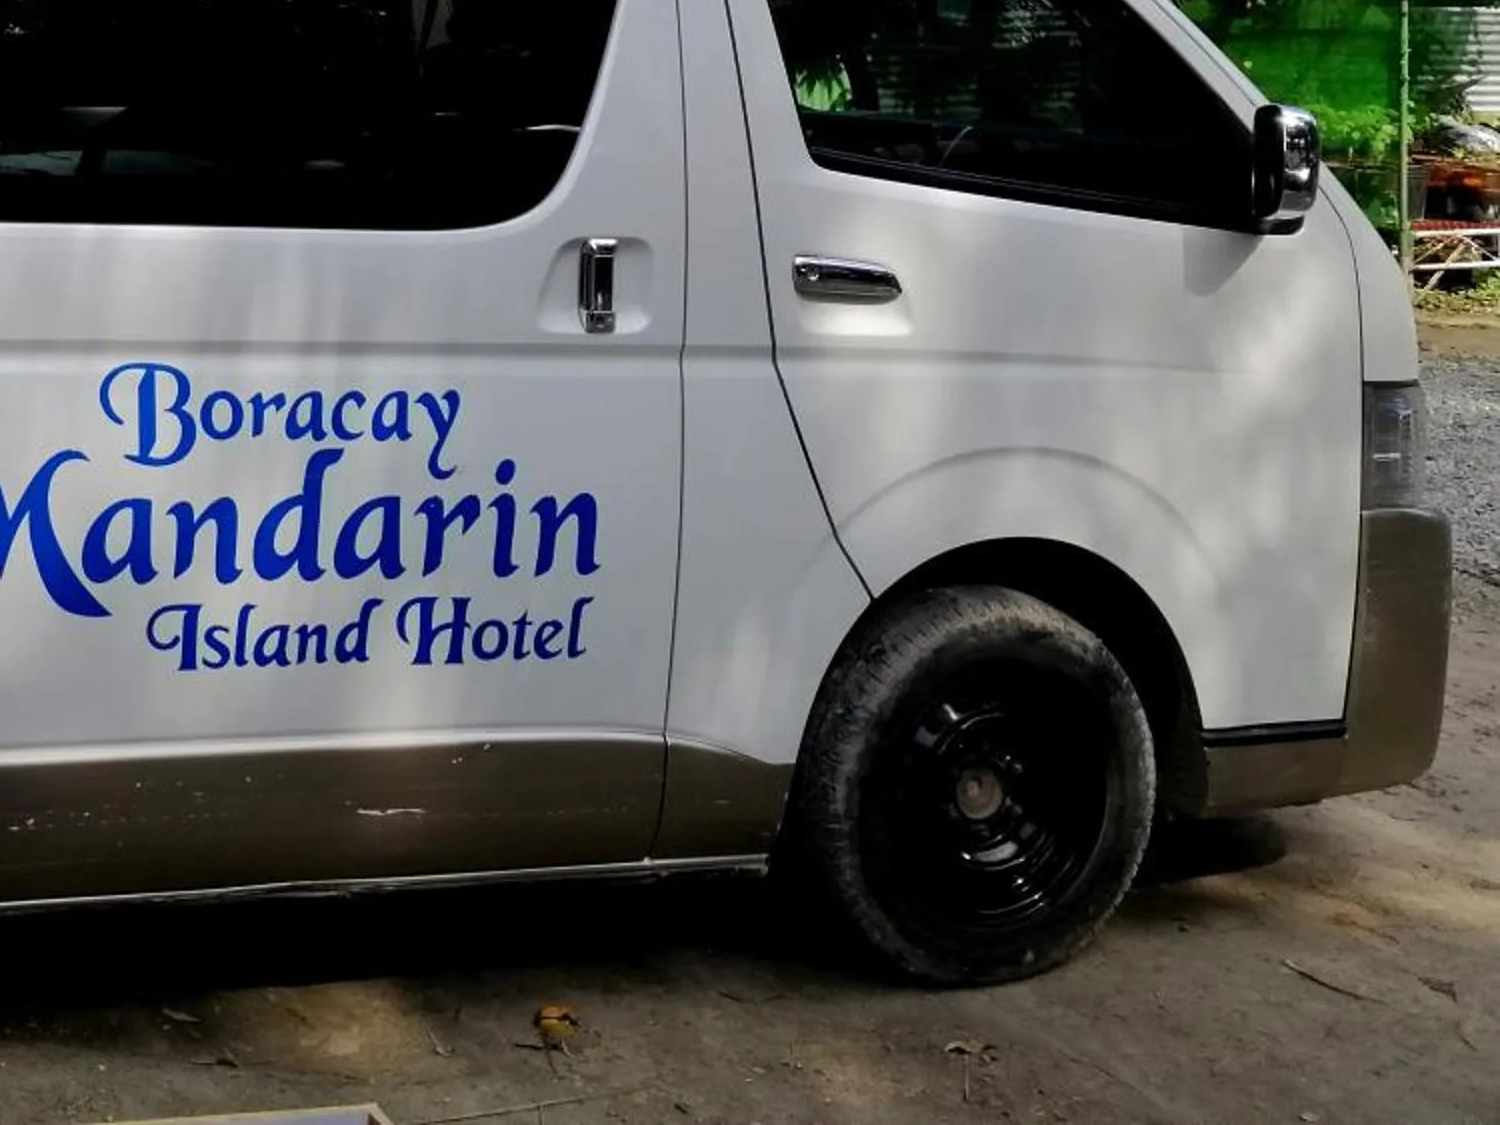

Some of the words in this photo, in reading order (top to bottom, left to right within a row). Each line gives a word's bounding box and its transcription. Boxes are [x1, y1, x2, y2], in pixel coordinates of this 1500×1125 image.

[99, 361, 462, 480] Boracay
[146, 597, 386, 672] Island
[396, 595, 595, 666] Hotel
